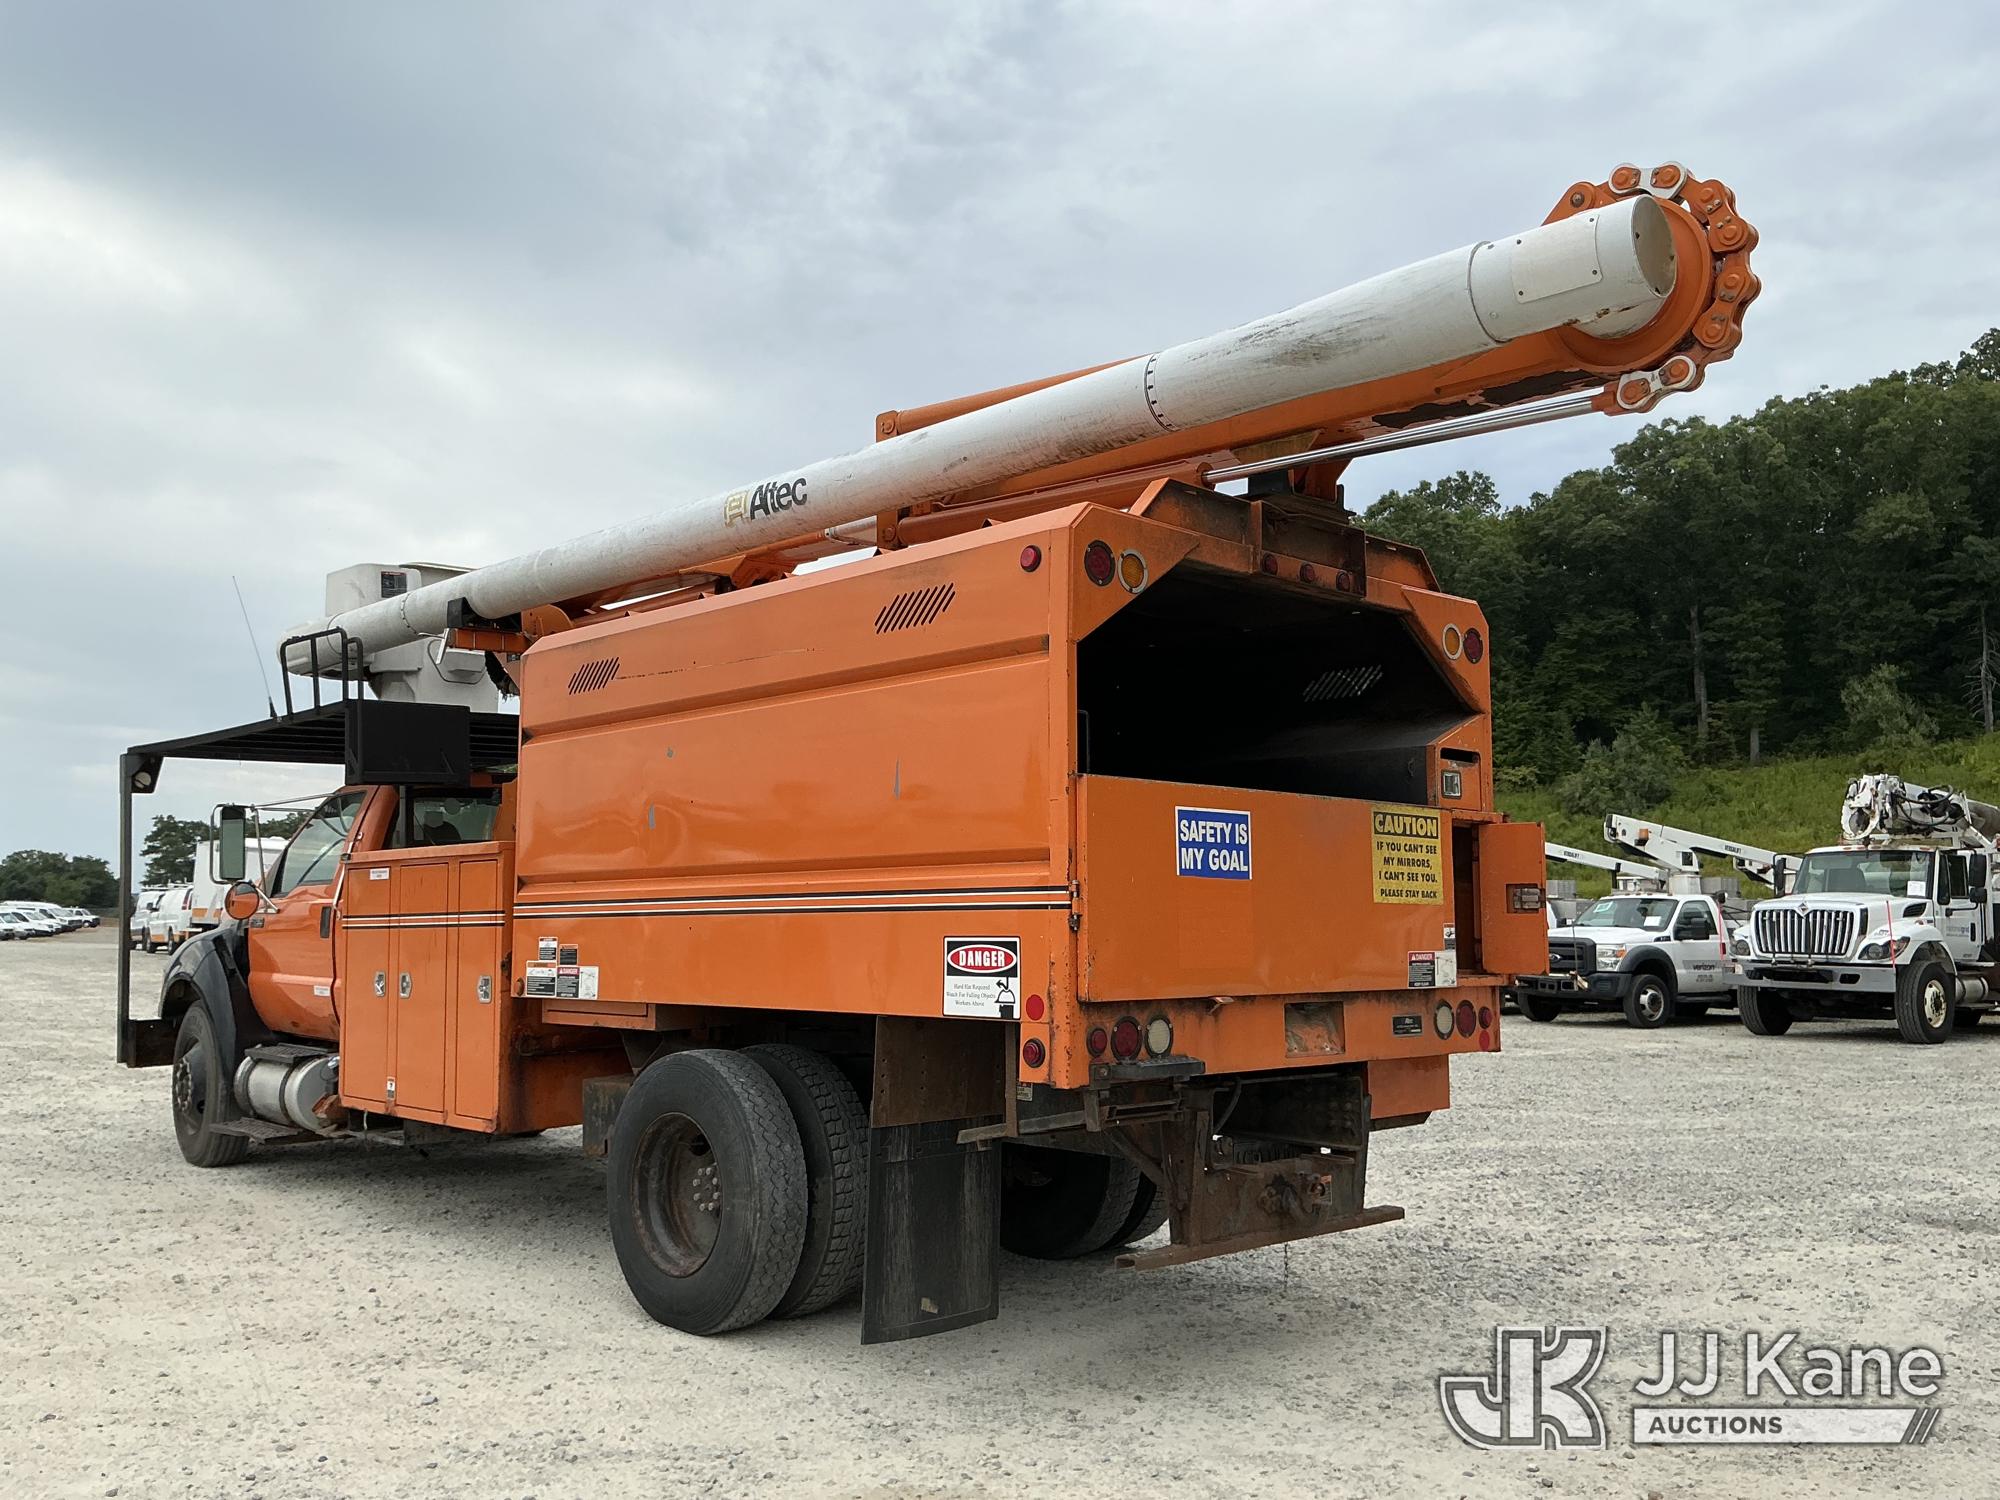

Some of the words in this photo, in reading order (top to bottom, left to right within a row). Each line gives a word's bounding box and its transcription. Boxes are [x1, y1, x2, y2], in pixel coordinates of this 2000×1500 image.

[750, 478, 807, 520] Altec
[1180, 819, 1232, 843] SAFETY
[1235, 823, 1248, 844] IS
[1374, 814, 1437, 837] CAUTION
[1377, 841, 1384, 850] IF
[1386, 842, 1402, 851] YOU
[1425, 845, 1437, 855] SEE
[1181, 847, 1205, 870] MY
[1208, 848, 1249, 872] GOAL
[1383, 857, 1395, 866] MY
[1397, 858, 1432, 870] MIRRORS,
[1407, 872, 1419, 882] SEE
[1421, 873, 1438, 883] YOU.
[1380, 888, 1404, 898] PLEASE
[1405, 889, 1420, 898] STAY
[1421, 890, 1437, 899] BACK
[959, 950, 1006, 967] DANGER
